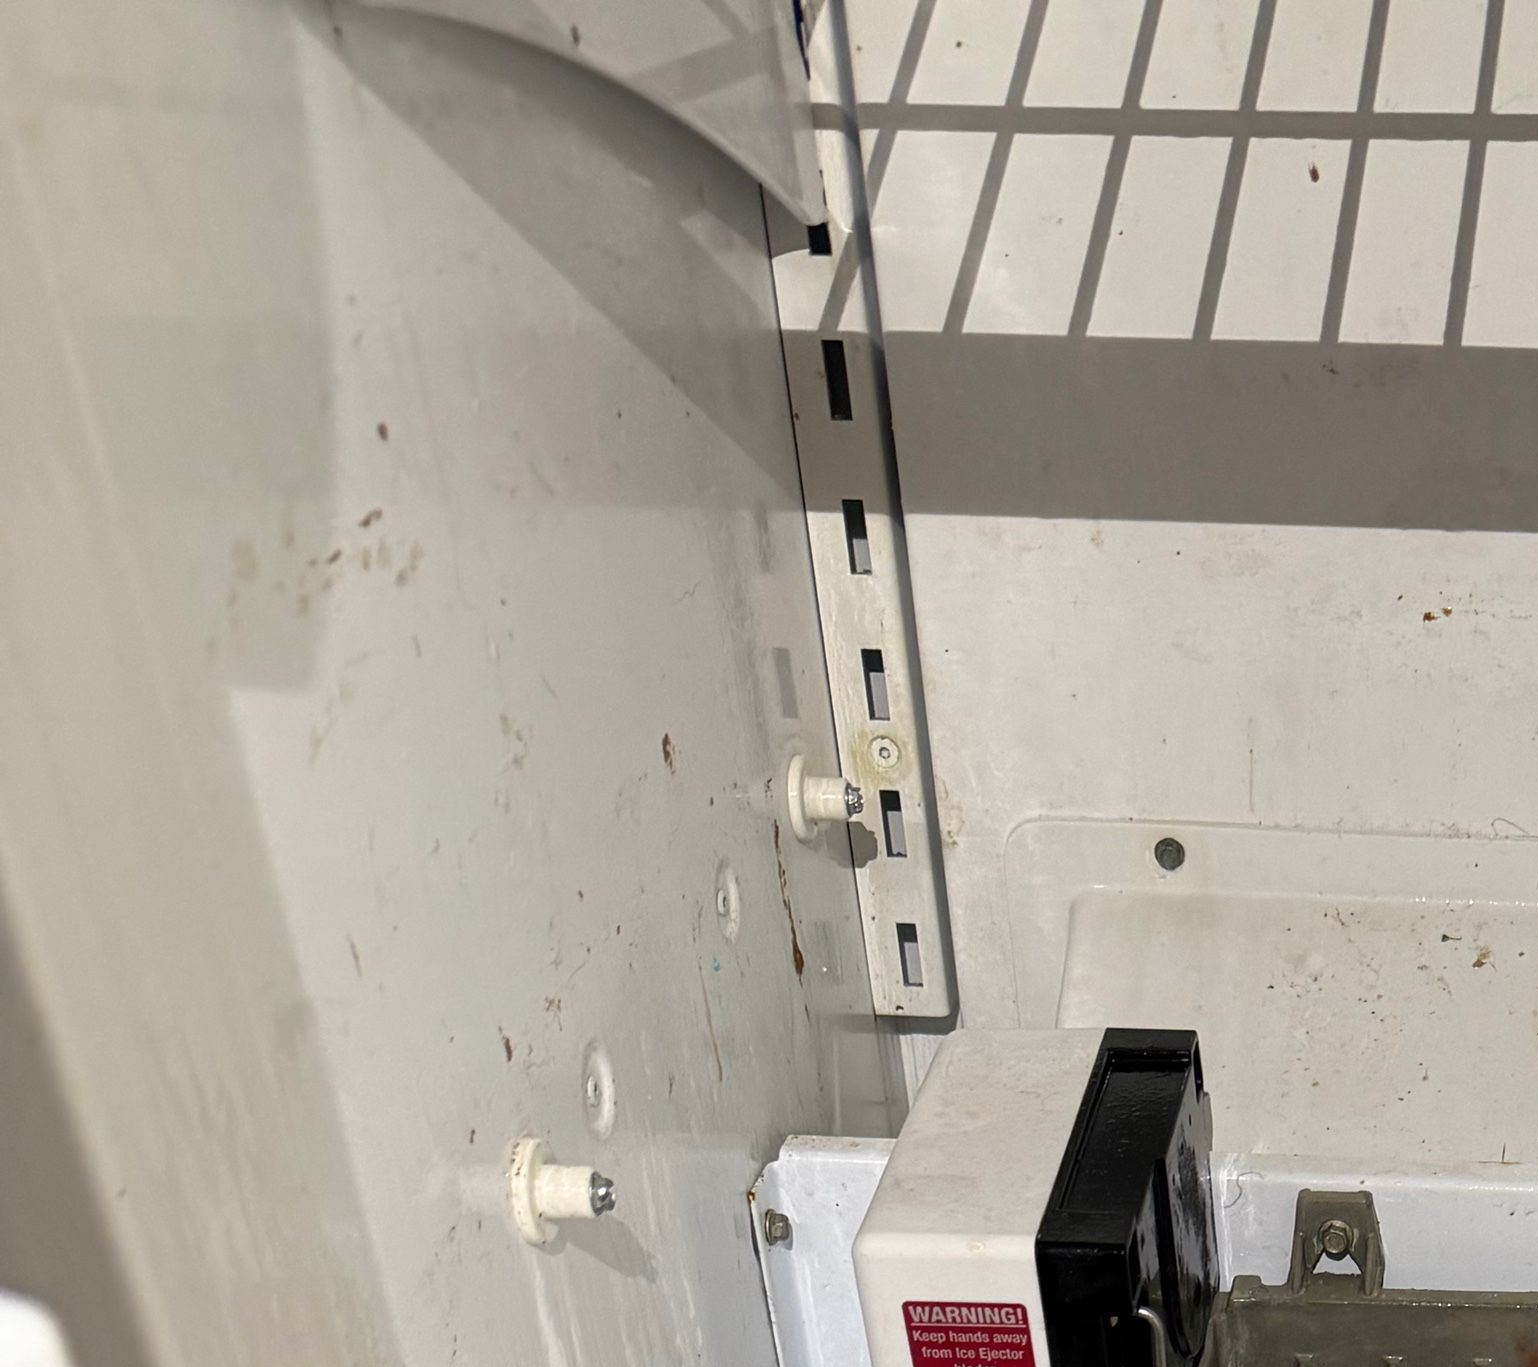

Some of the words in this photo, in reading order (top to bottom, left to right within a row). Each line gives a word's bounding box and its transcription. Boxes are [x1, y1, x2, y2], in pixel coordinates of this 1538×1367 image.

[908, 1306, 1024, 1324] WARNING!
[912, 1330, 946, 1343] Keep
[950, 1331, 989, 1342] hands
[993, 1333, 1027, 1345] away
[922, 1347, 952, 1358] from
[956, 1348, 975, 1358] Ice
[979, 1348, 1024, 1361] Ejector
